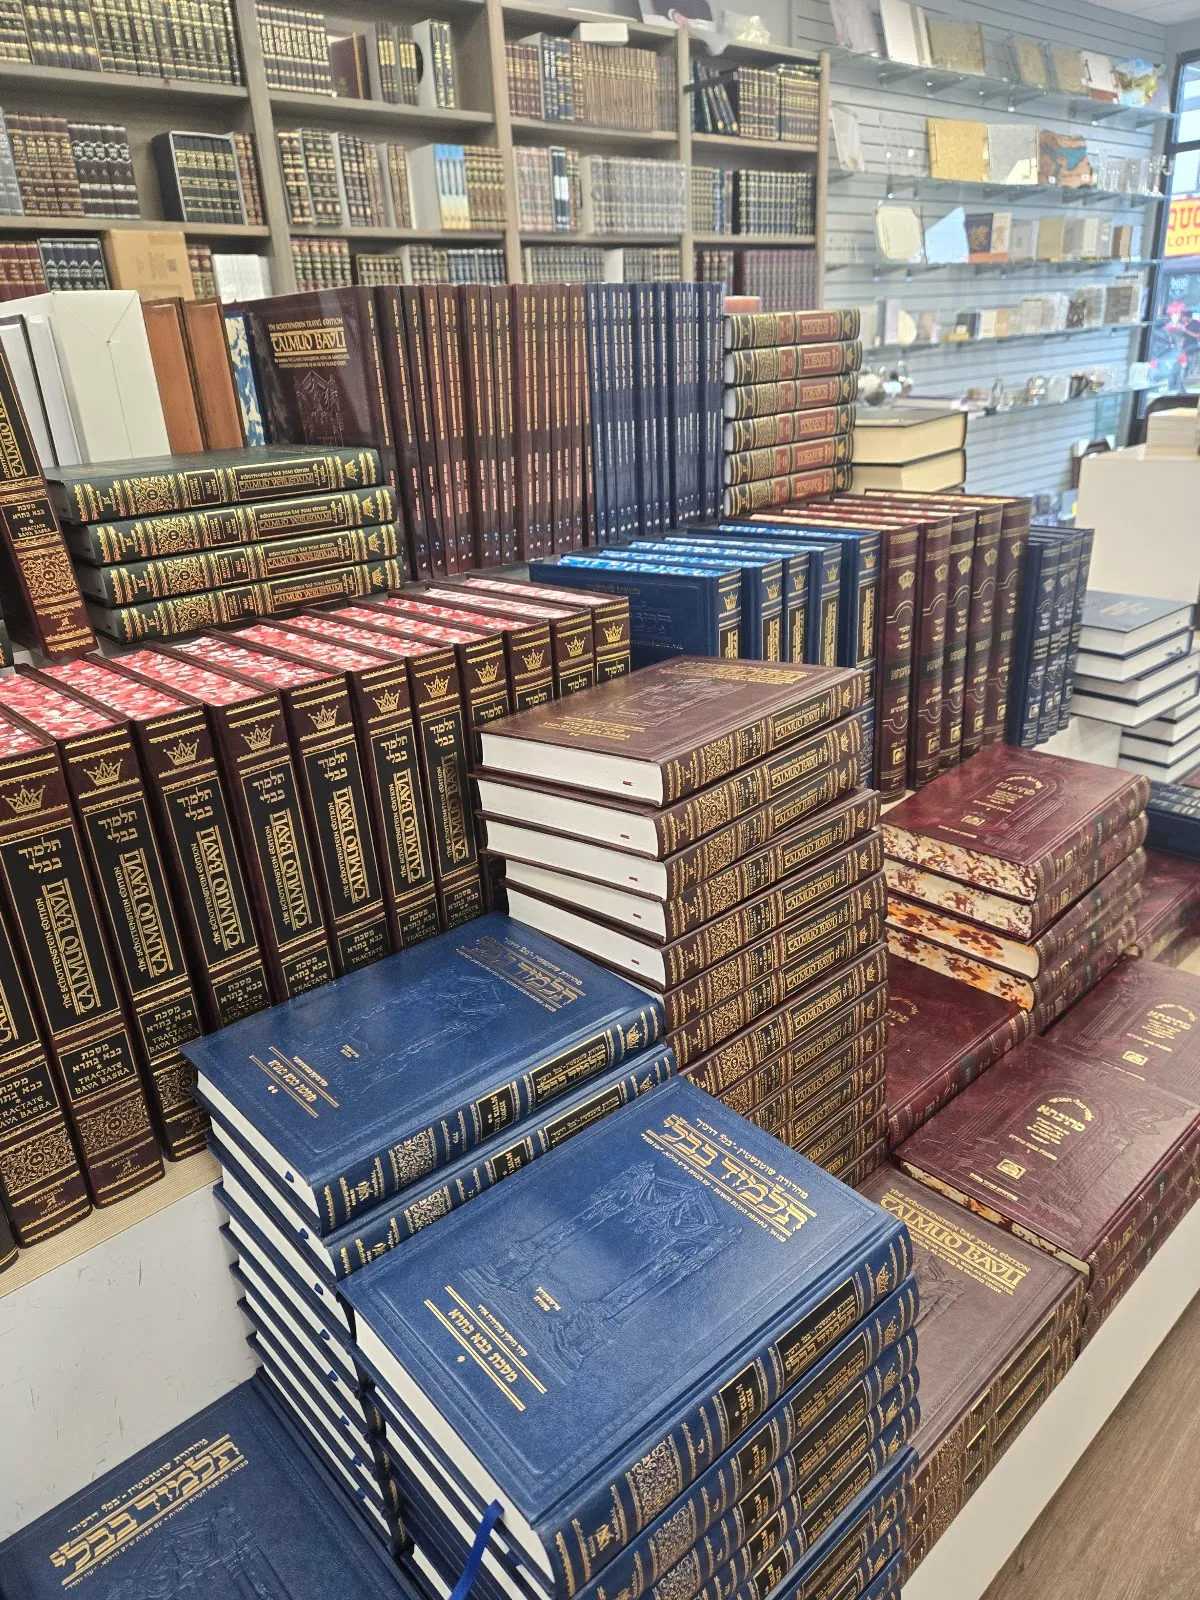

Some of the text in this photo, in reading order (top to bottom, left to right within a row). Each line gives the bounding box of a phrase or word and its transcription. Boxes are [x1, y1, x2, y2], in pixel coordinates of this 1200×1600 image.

[380, 733, 408, 752] תלמוד
[317, 750, 348, 769] תלמוד
[385, 749, 408, 764] בבלי
[252, 770, 285, 791] תלמוד
[324, 767, 348, 782] בבלי
[177, 786, 213, 807] תלמוד
[260, 788, 286, 805] בבלי
[97, 808, 137, 830] תלמוד
[185, 805, 214, 821] בבלי
[107, 827, 138, 843] בבלי
[18, 837, 62, 859] תלמוד
[28, 857, 63, 874] בבלי
[123, 850, 168, 977] TALMUD BAVLI
[47, 880, 95, 1014] TALMUD BAVLI
[515, 961, 578, 1006] תלמוד
[146, 1009, 193, 1033] בבא בתרא
[154, 1005, 181, 1021] מסכת
[72, 1047, 123, 1074] בבא בתרא
[80, 1044, 110, 1060] מסכת
[22, 1079, 44, 1095] בבא
[98, 1067, 130, 1086] BASRA
[20, 1100, 52, 1119] BASRA
[660, 1113, 719, 1168] בבלי
[737, 1148, 809, 1200] מהדורת שוטנשטין
[721, 1157, 808, 1231] תלמוד
[879, 1195, 1024, 1288] TALMUD BAVLI
[447, 1308, 518, 1383] מסכת בבא בתרא
[127, 1438, 209, 1496] מהדורת שוטנשטין
[49, 1441, 241, 1571] תלמוד בבלי
